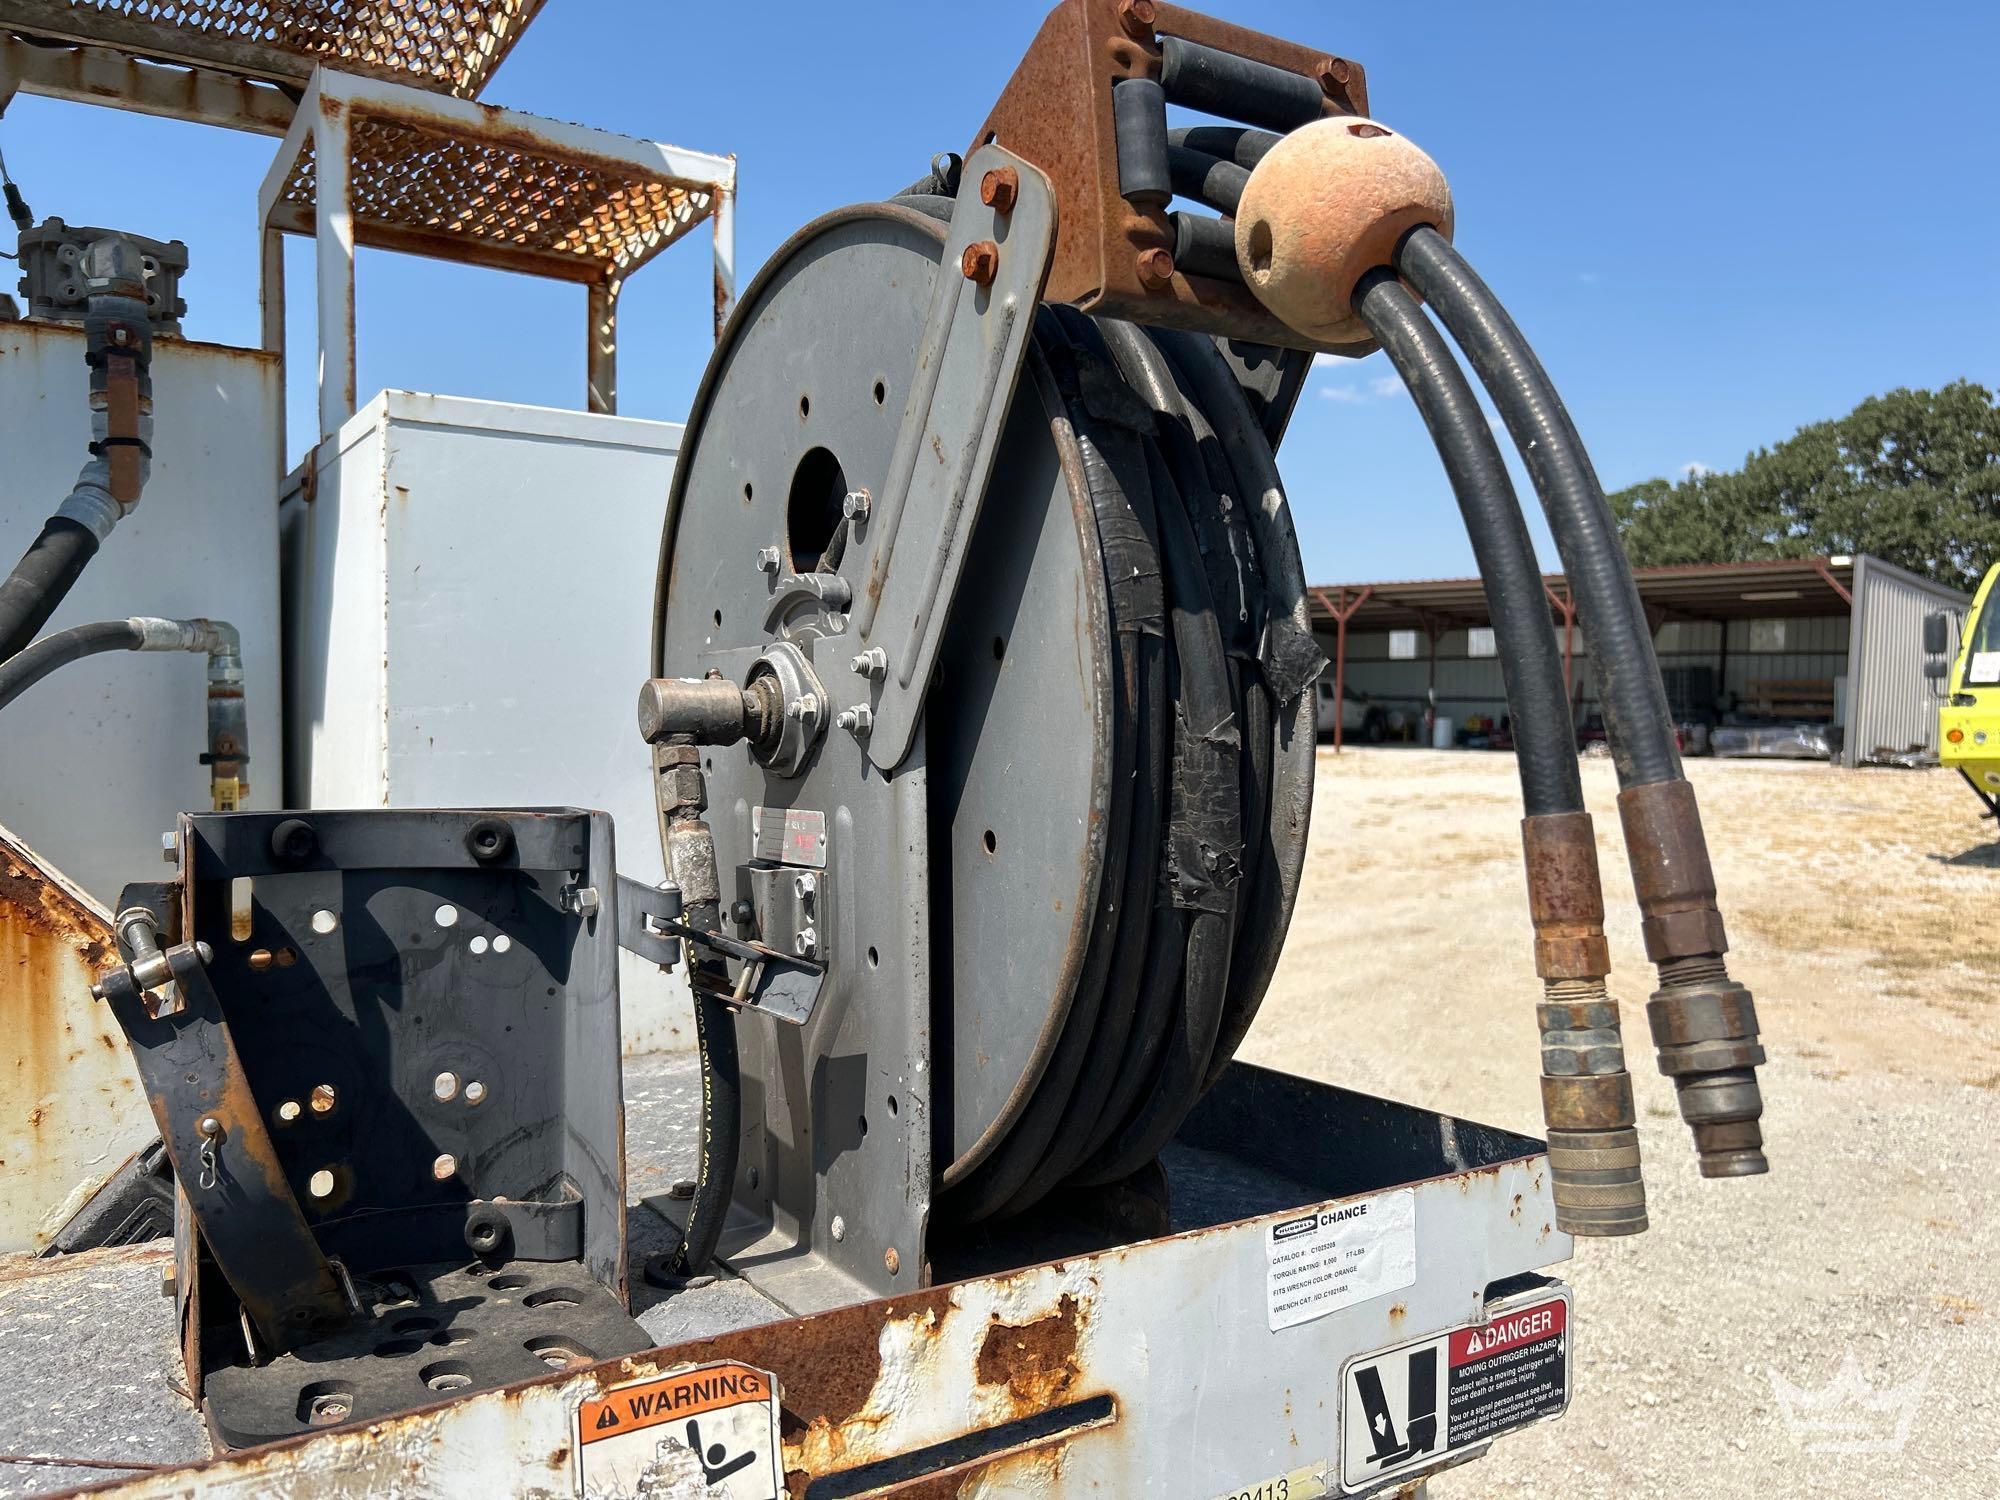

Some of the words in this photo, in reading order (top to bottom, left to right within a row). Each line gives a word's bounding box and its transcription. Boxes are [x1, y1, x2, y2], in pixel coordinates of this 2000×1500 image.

[1320, 1204, 1367, 1226] CHANCE
[1272, 1251, 1300, 1265] CATALOG
[1273, 1268, 1297, 1281] TORQUE
[1346, 1247, 1365, 1259] FT-LBS
[1272, 1287, 1287, 1297] FITS
[1287, 1279, 1312, 1293] WRENCH
[1334, 1265, 1358, 1278] ORANGE
[1273, 1300, 1299, 1314] WRENCH
[1485, 1310, 1552, 1349] DANGER
[1450, 1380, 1475, 1396] Contact
[1475, 1376, 1489, 1387] with
[1494, 1368, 1516, 1381] moving
[1517, 1358, 1544, 1373] outrigger
[1544, 1353, 1555, 1364] will
[1459, 1361, 1487, 1378] MOVING
[1488, 1347, 1529, 1369] OUTRIGGER
[1529, 1339, 1557, 1354] HAZARD
[629, 1374, 761, 1420] WARNING
[1450, 1393, 1468, 1406] cause
[1469, 1386, 1487, 1399] death
[1487, 1384, 1495, 1393] or
[1495, 1377, 1518, 1390] serious
[1518, 1371, 1536, 1383] injury.
[1450, 1413, 1462, 1423] You
[1462, 1410, 1469, 1419] or
[1475, 1401, 1493, 1415] signal
[1493, 1395, 1514, 1410] person
[1514, 1389, 1529, 1401] must
[1529, 1386, 1540, 1396] see
[1540, 1381, 1552, 1392] that
[1449, 1416, 1478, 1436] personnel
[1478, 1412, 1490, 1423] and
[1490, 1402, 1525, 1419] obstructions
[1524, 1398, 1534, 1407] are
[1534, 1392, 1548, 1403] clear
[1547, 1388, 1554, 1399] of
[1554, 1387, 1564, 1396] the
[1449, 1427, 1477, 1443] outrigger
[1477, 1421, 1490, 1433] and
[1489, 1420, 1498, 1429] its
[1498, 1411, 1520, 1426] contact
[1520, 1406, 1536, 1420] point.
